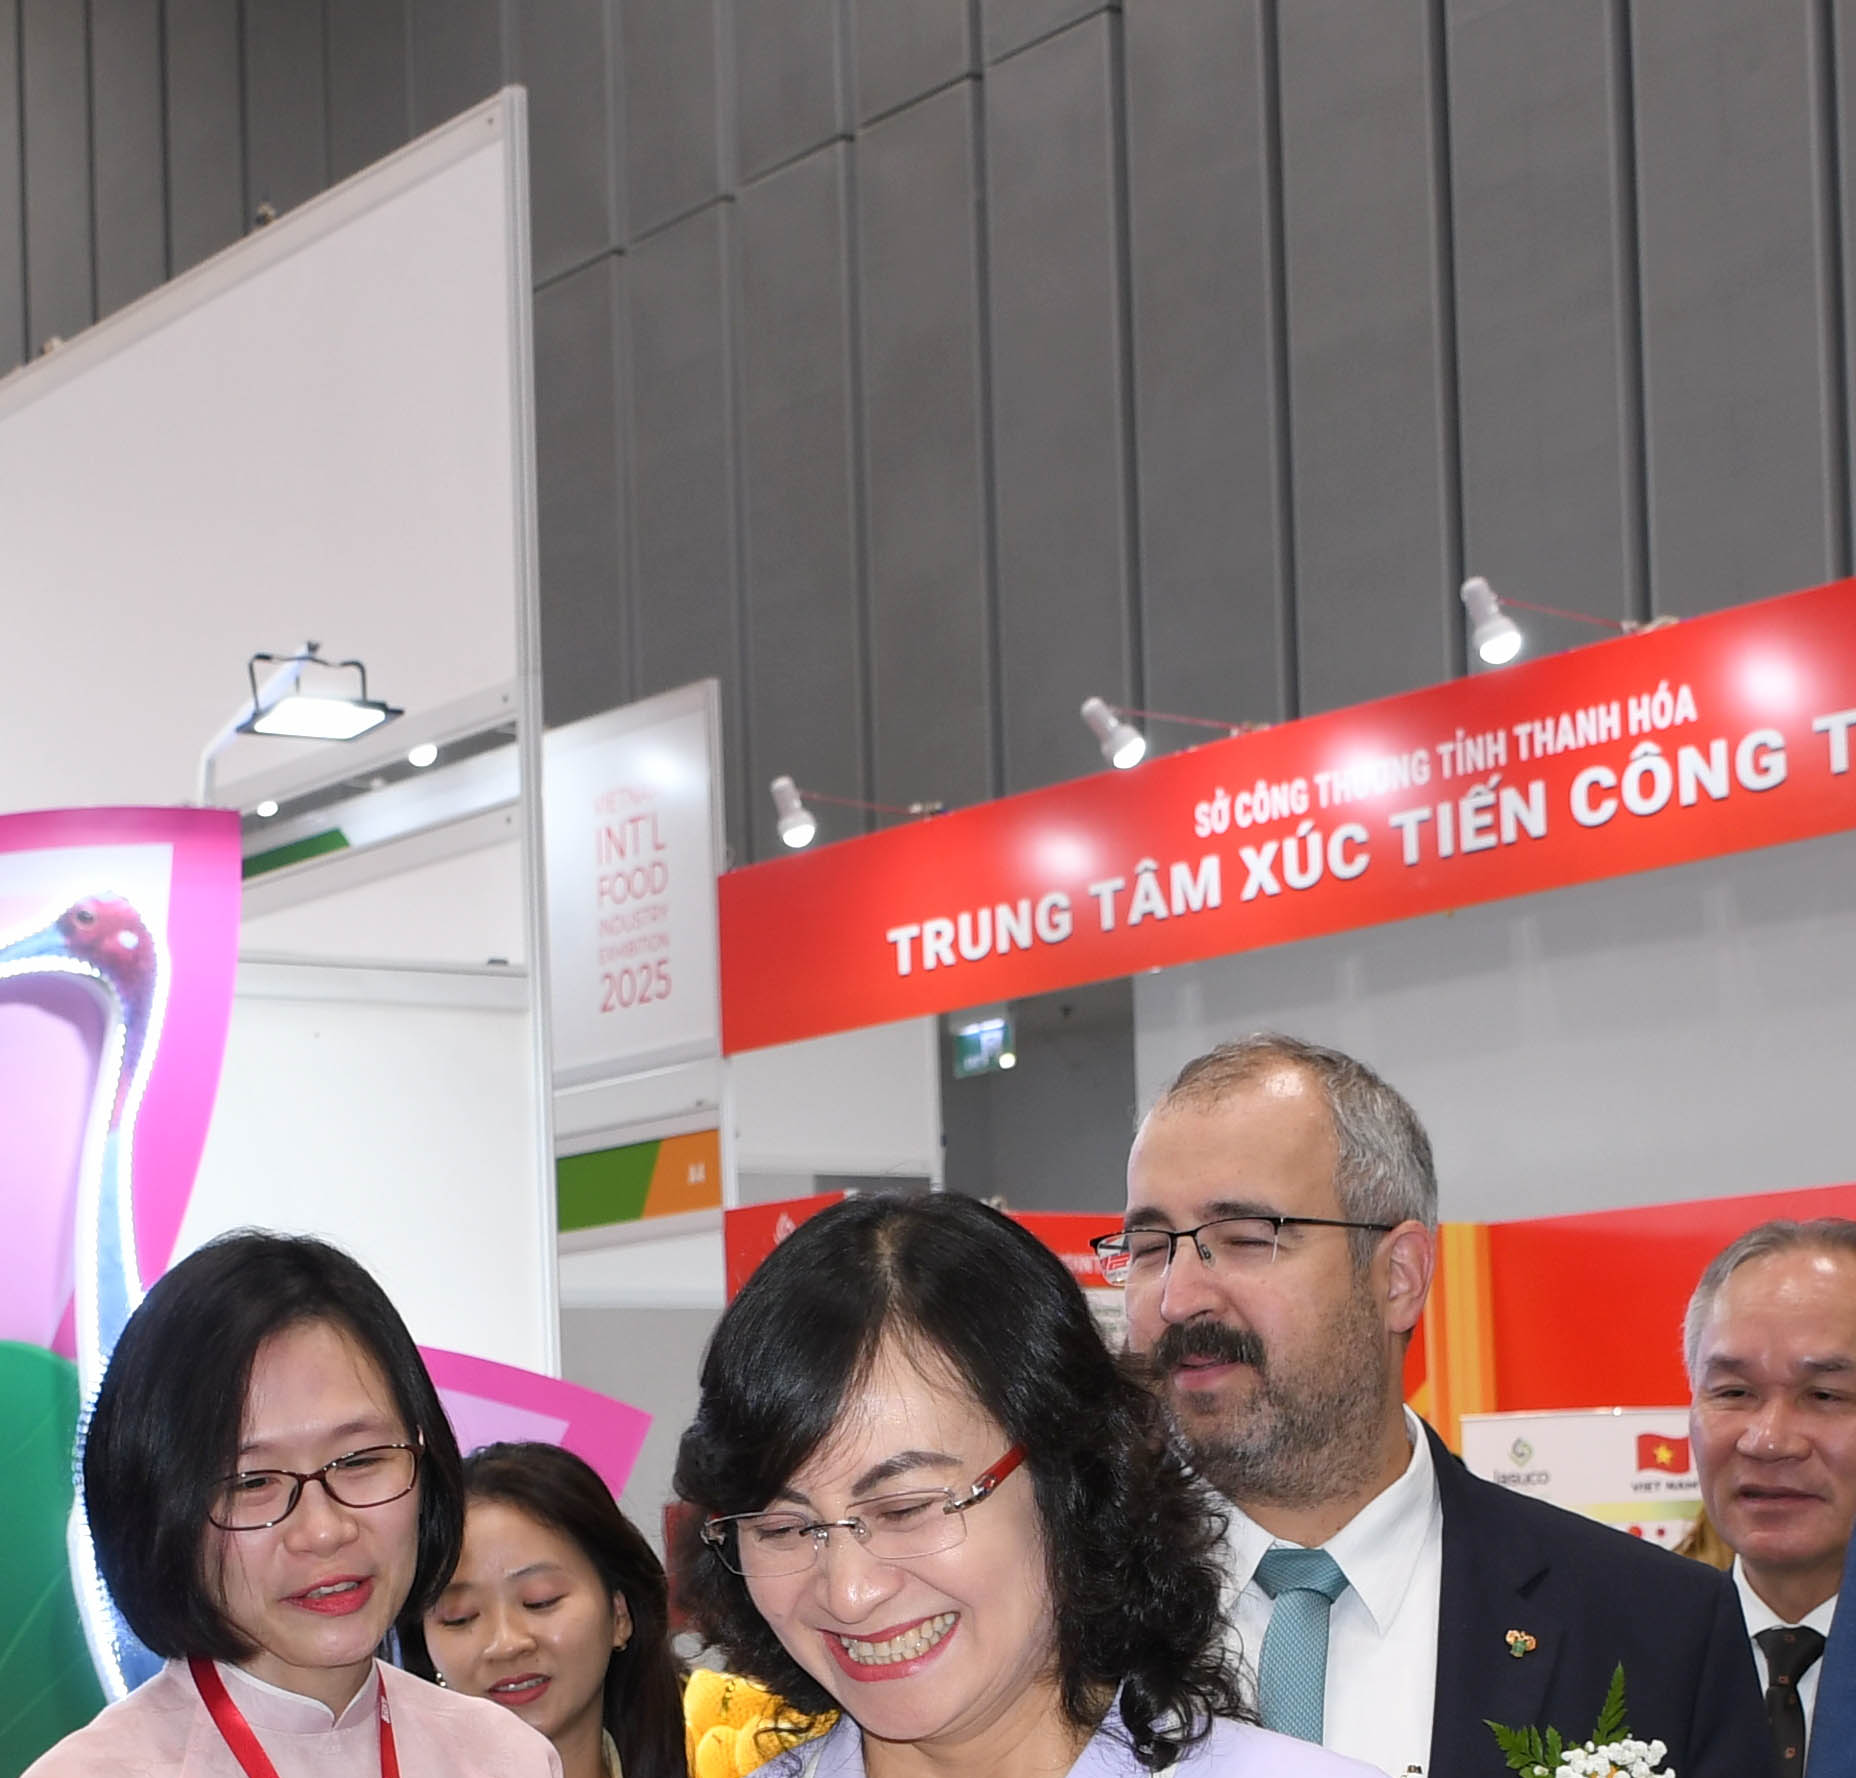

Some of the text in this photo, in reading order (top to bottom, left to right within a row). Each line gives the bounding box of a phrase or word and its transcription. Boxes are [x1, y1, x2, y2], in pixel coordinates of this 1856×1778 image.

[1194, 681, 1699, 838] SỞ CÔNG THƯƠNG TỈNH THANH HÓA
[598, 859, 669, 909] FOOD
[885, 891, 1075, 977] TRUNG
[1088, 853, 1223, 933] TÂM
[1239, 820, 1371, 903] XÚC
[1388, 772, 1548, 867] TIẾN
[1568, 728, 1788, 829] CÔNG
[600, 959, 673, 1013] 2025
